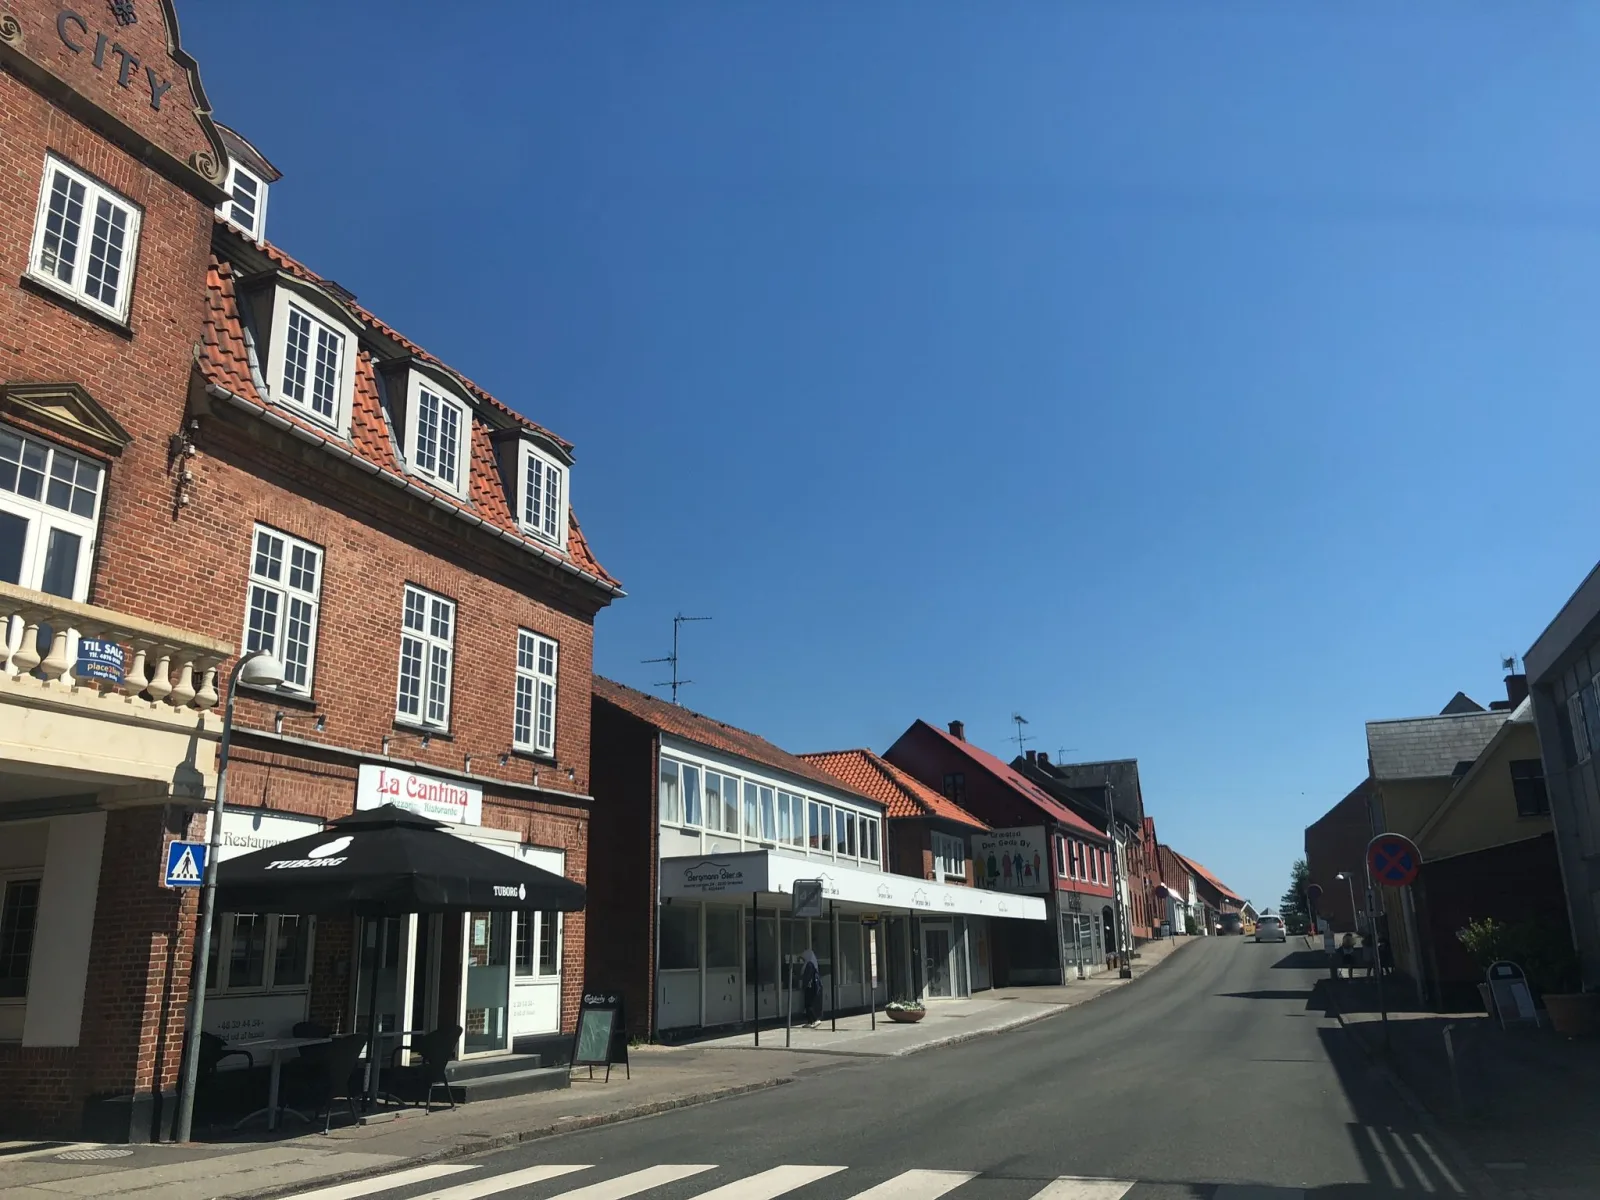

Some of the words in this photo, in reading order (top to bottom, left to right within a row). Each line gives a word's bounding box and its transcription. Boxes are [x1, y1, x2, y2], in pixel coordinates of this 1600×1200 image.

[57, 9, 171, 110] CITY
[83, 641, 101, 652] TIL
[104, 643, 123, 660] SALG
[376, 769, 400, 795] La
[406, 775, 468, 806] Cantina
[424, 802, 458, 816] Ristorante
[981, 842, 996, 850] Den
[1019, 839, 1031, 848] By
[264, 856, 349, 870] TUBORG
[685, 870, 719, 882] Bergmann
[493, 885, 518, 897] TUBORG
